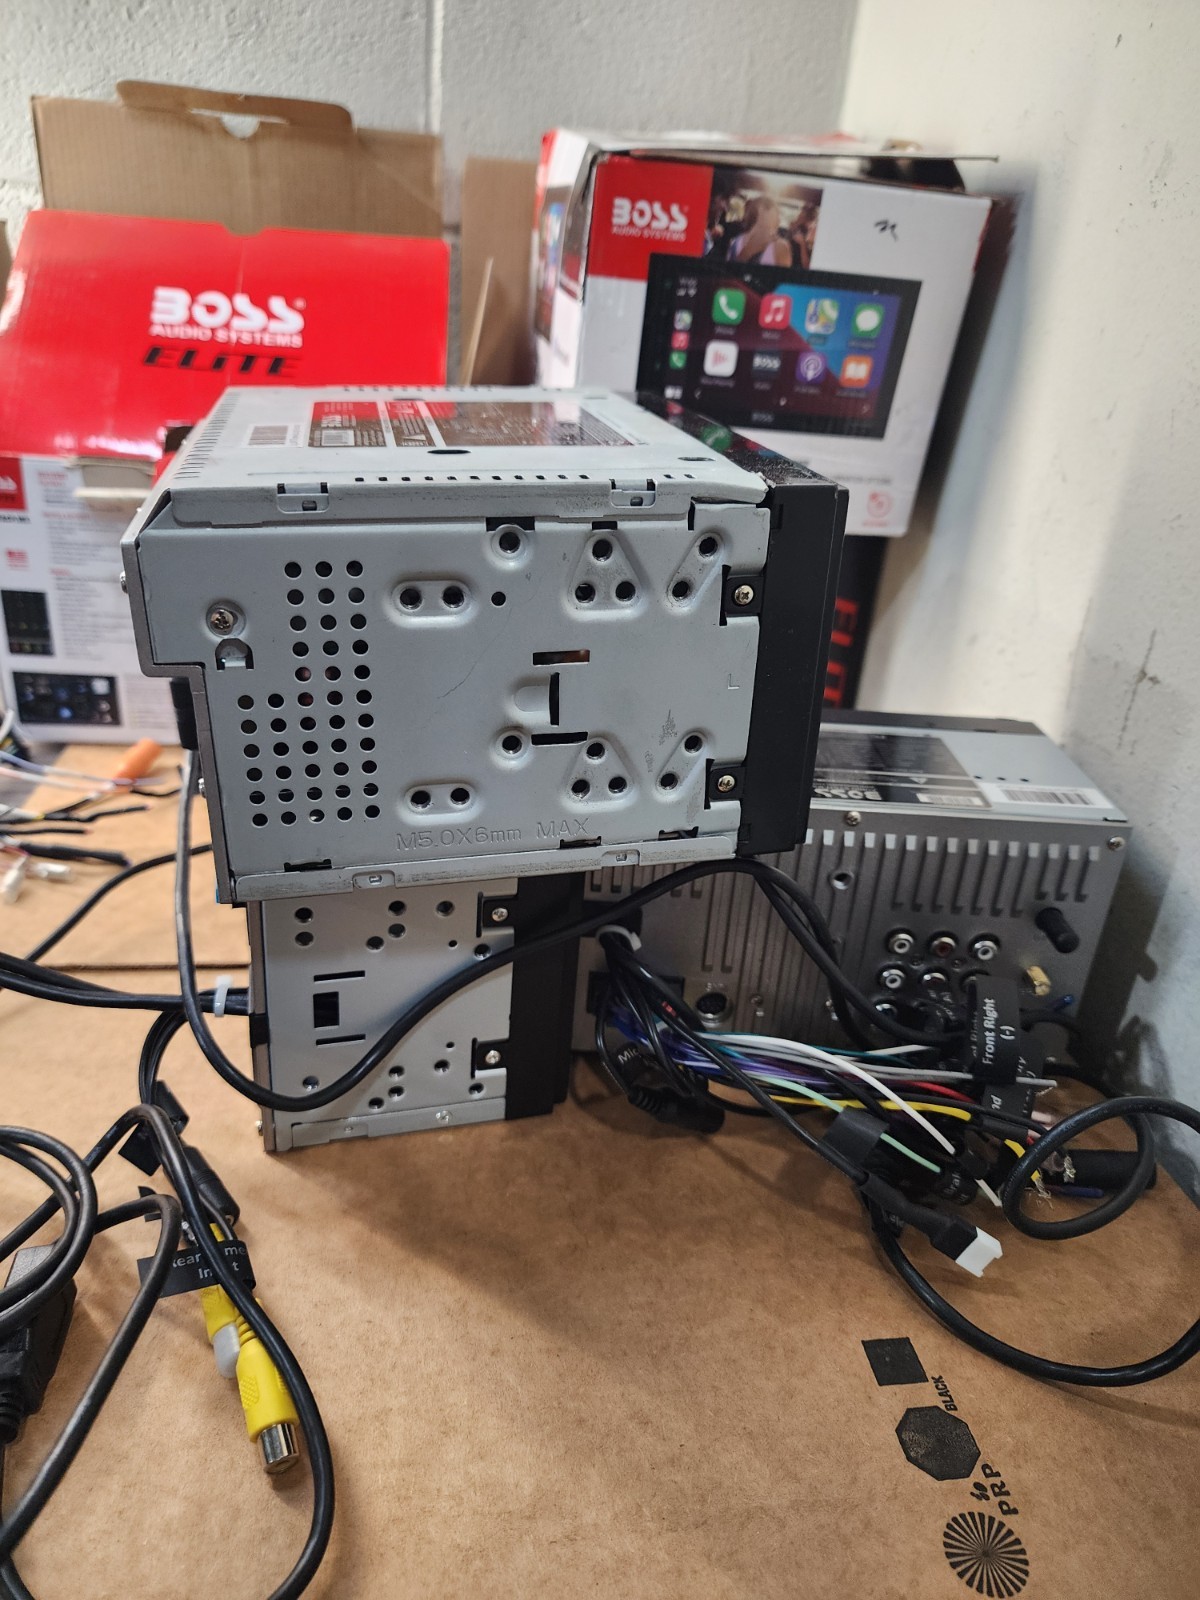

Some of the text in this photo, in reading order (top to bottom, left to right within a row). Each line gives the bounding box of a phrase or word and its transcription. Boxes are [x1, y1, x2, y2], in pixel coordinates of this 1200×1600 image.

[612, 197, 688, 232] BOSS
[612, 226, 687, 242] AUDIO SYSTEMS
[150, 286, 304, 334] BOSS
[149, 323, 303, 349] AUDIO SYSTEMS
[143, 346, 304, 379] ELITE
[727, 673, 740, 690] L
[396, 817, 590, 852] M5.0X6mm MAX
[982, 998, 998, 1065] Front Right
[1000, 1025, 1015, 1040] (-)
[931, 1374, 958, 1412] BLACK
[981, 1463, 1019, 1515] PRP
